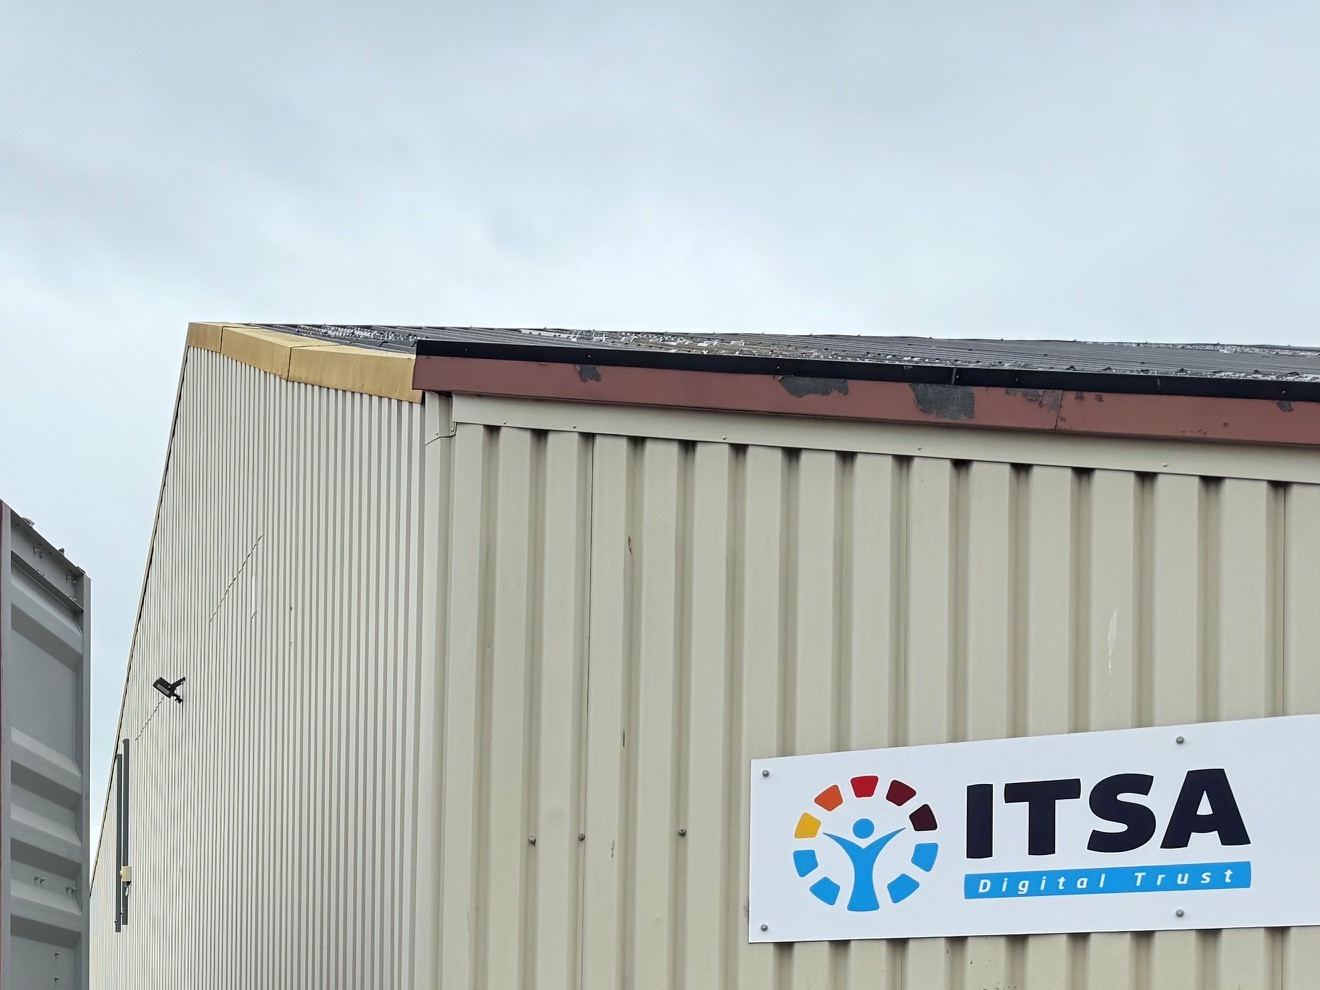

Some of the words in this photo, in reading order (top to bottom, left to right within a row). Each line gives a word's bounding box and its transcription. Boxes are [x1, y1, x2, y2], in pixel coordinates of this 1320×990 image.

[966, 768, 1252, 859] ITSA
[979, 873, 1105, 897] Digital
[1135, 868, 1235, 887] Trust
